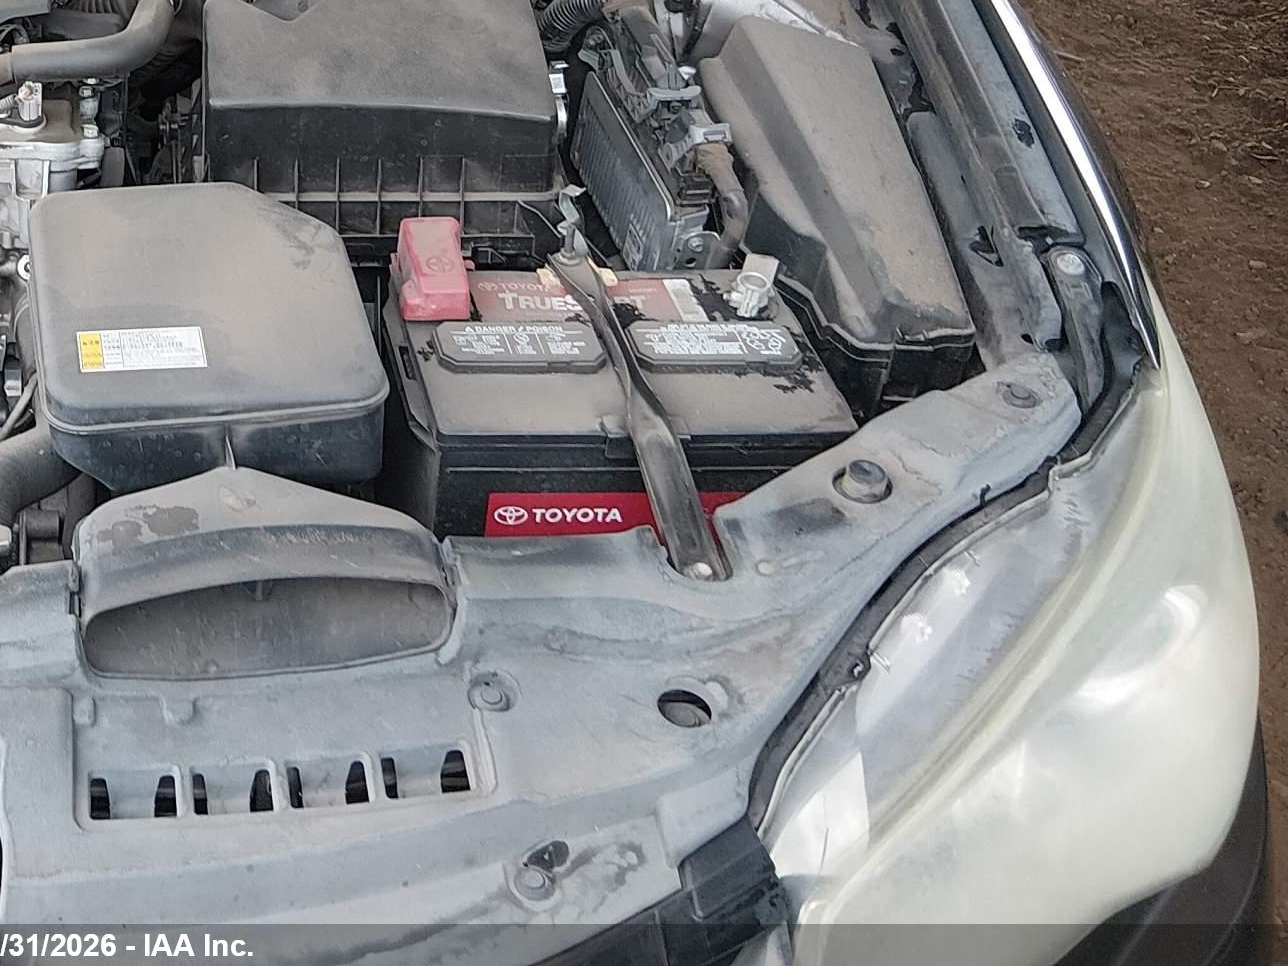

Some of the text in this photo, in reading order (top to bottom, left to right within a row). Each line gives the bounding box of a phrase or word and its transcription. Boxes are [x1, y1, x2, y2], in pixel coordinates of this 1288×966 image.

[475, 325, 515, 333] DANGER
[525, 325, 563, 333] POISON
[532, 507, 623, 523] TOYOTA
